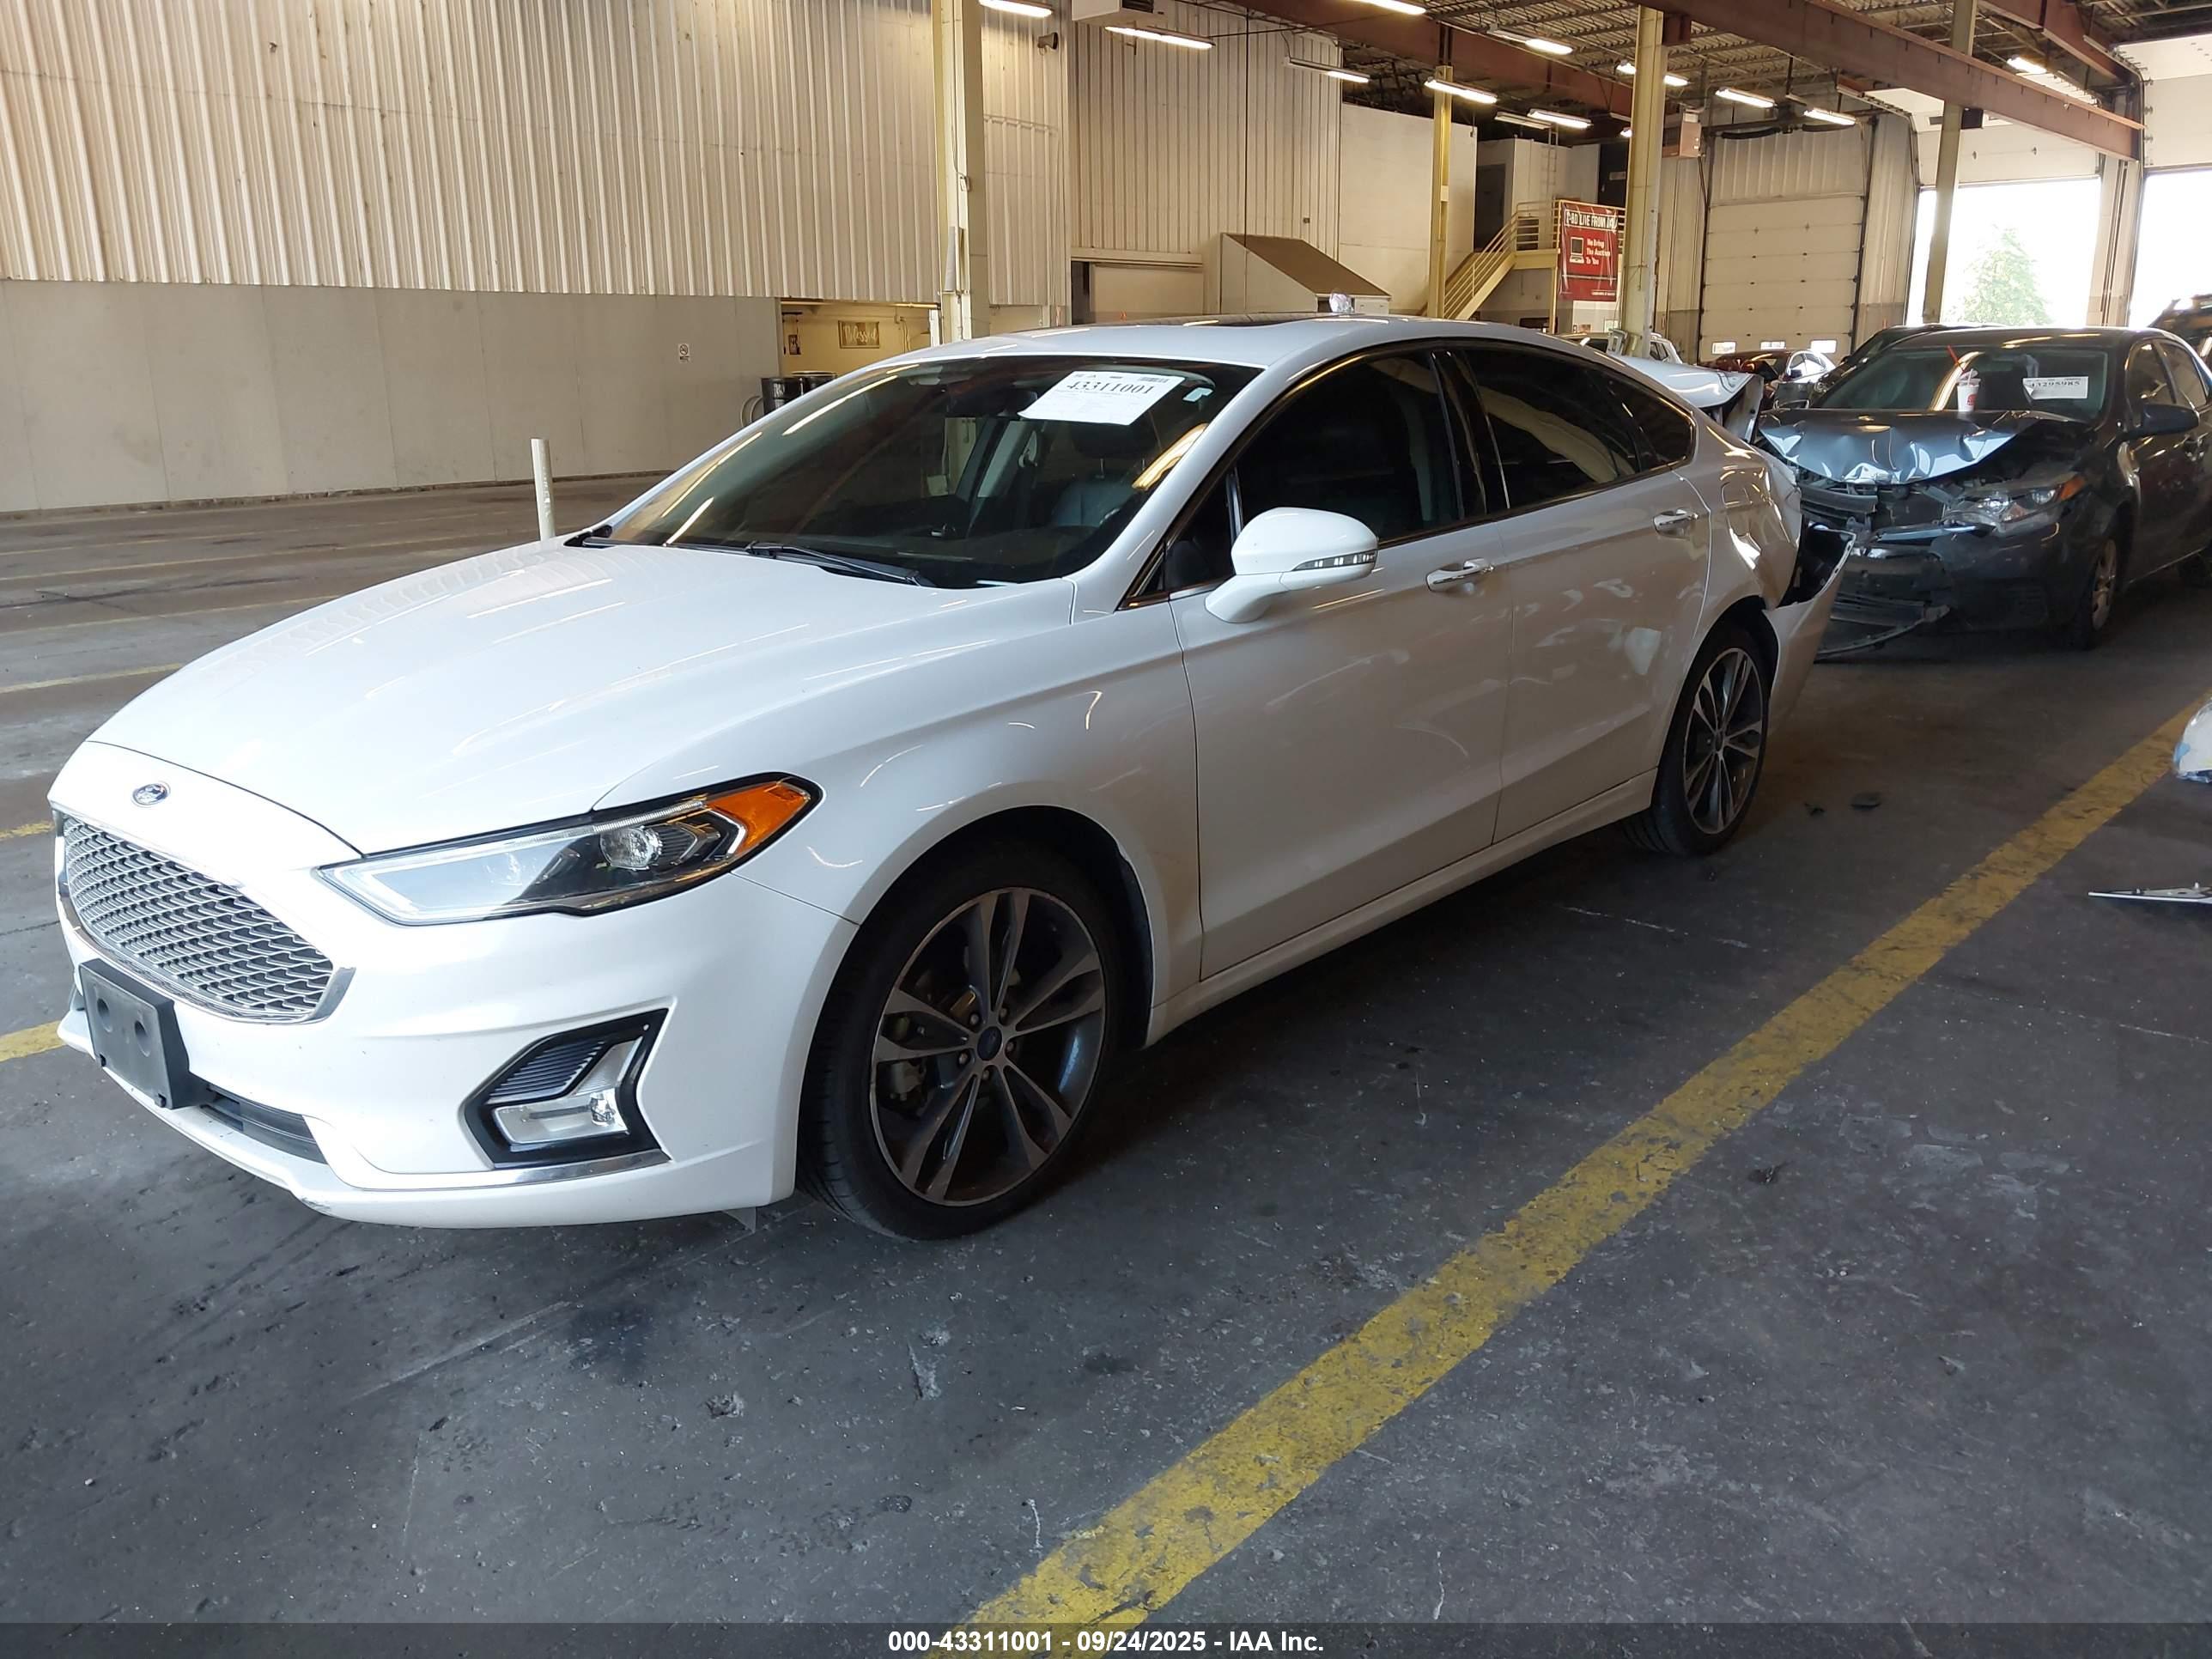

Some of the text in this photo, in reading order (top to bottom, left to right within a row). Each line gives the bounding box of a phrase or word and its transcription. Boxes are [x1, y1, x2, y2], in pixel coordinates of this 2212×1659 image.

[1579, 214, 1590, 226] LIVE
[1591, 215, 1606, 228] FROM
[1066, 380, 1155, 394] 43311001
